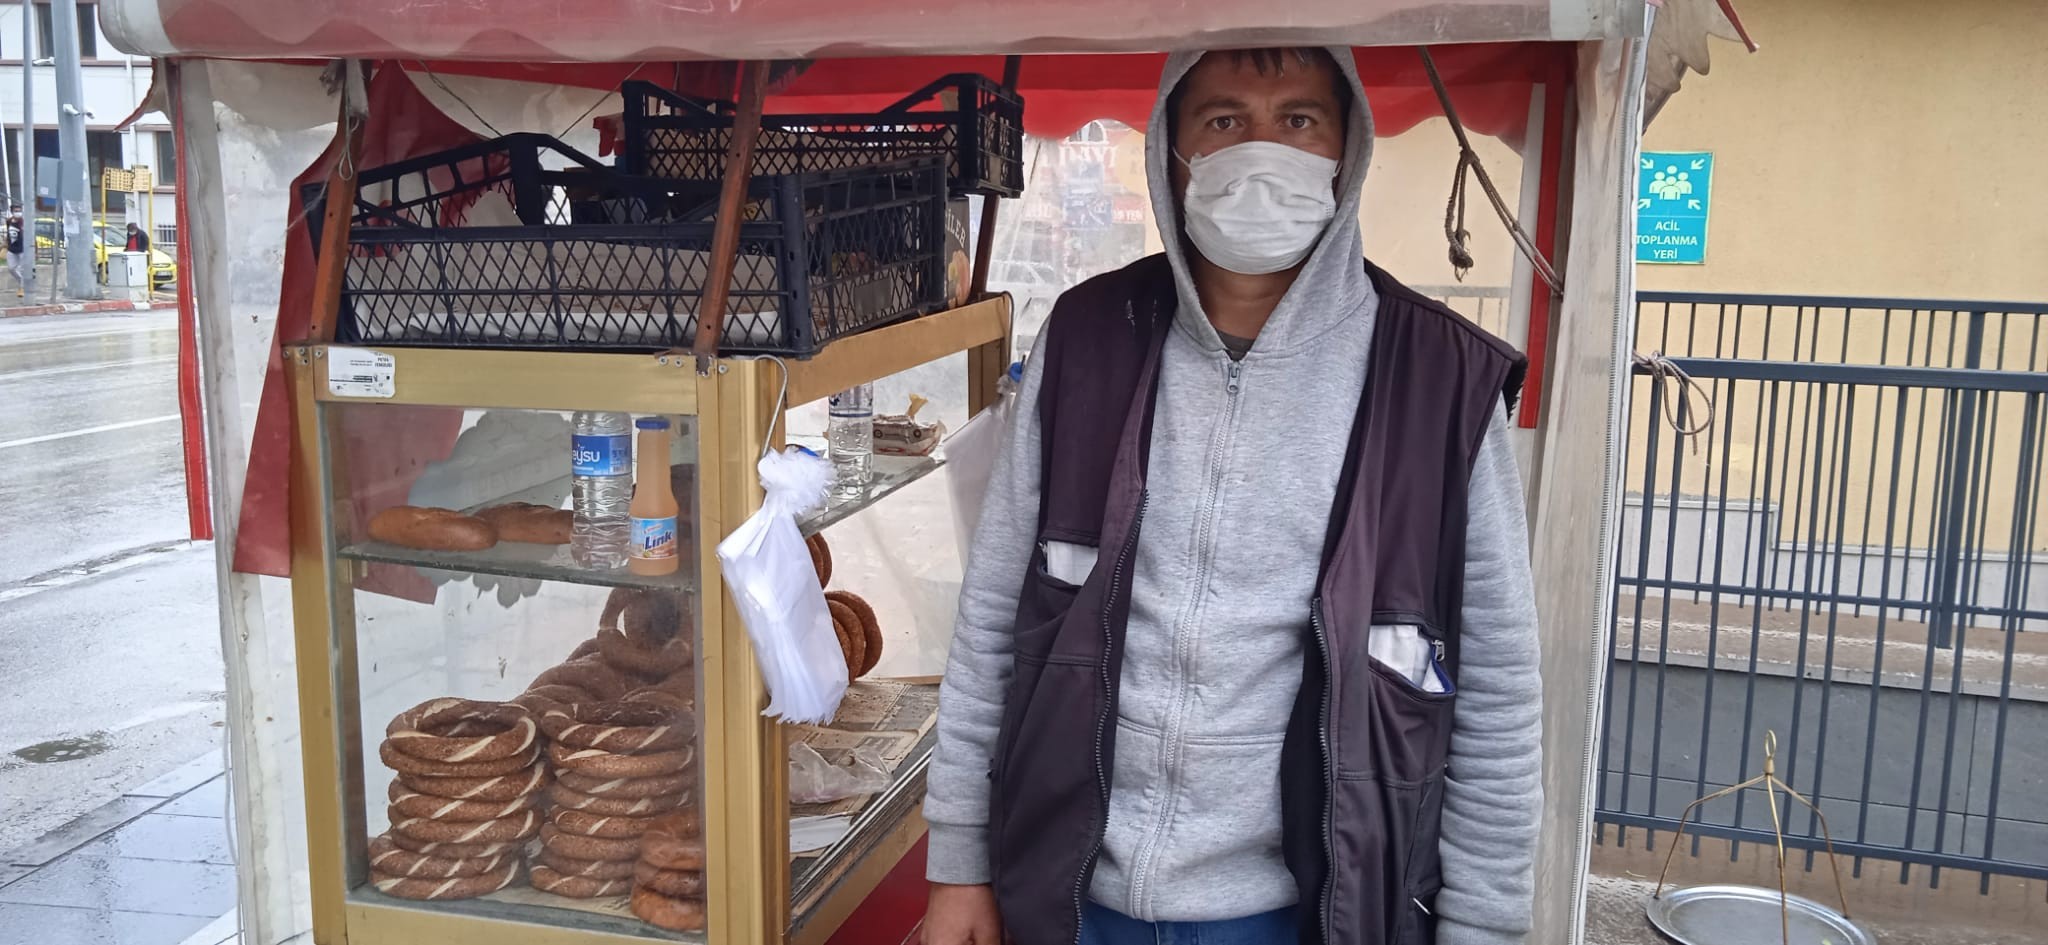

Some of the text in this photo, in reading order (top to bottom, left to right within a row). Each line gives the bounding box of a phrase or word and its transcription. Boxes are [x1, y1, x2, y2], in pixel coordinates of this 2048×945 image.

[1655, 219, 1680, 231] ACİL
[1635, 234, 1698, 246] TOPLANMA
[1653, 247, 1678, 259] YERİ
[644, 531, 673, 550] Link
